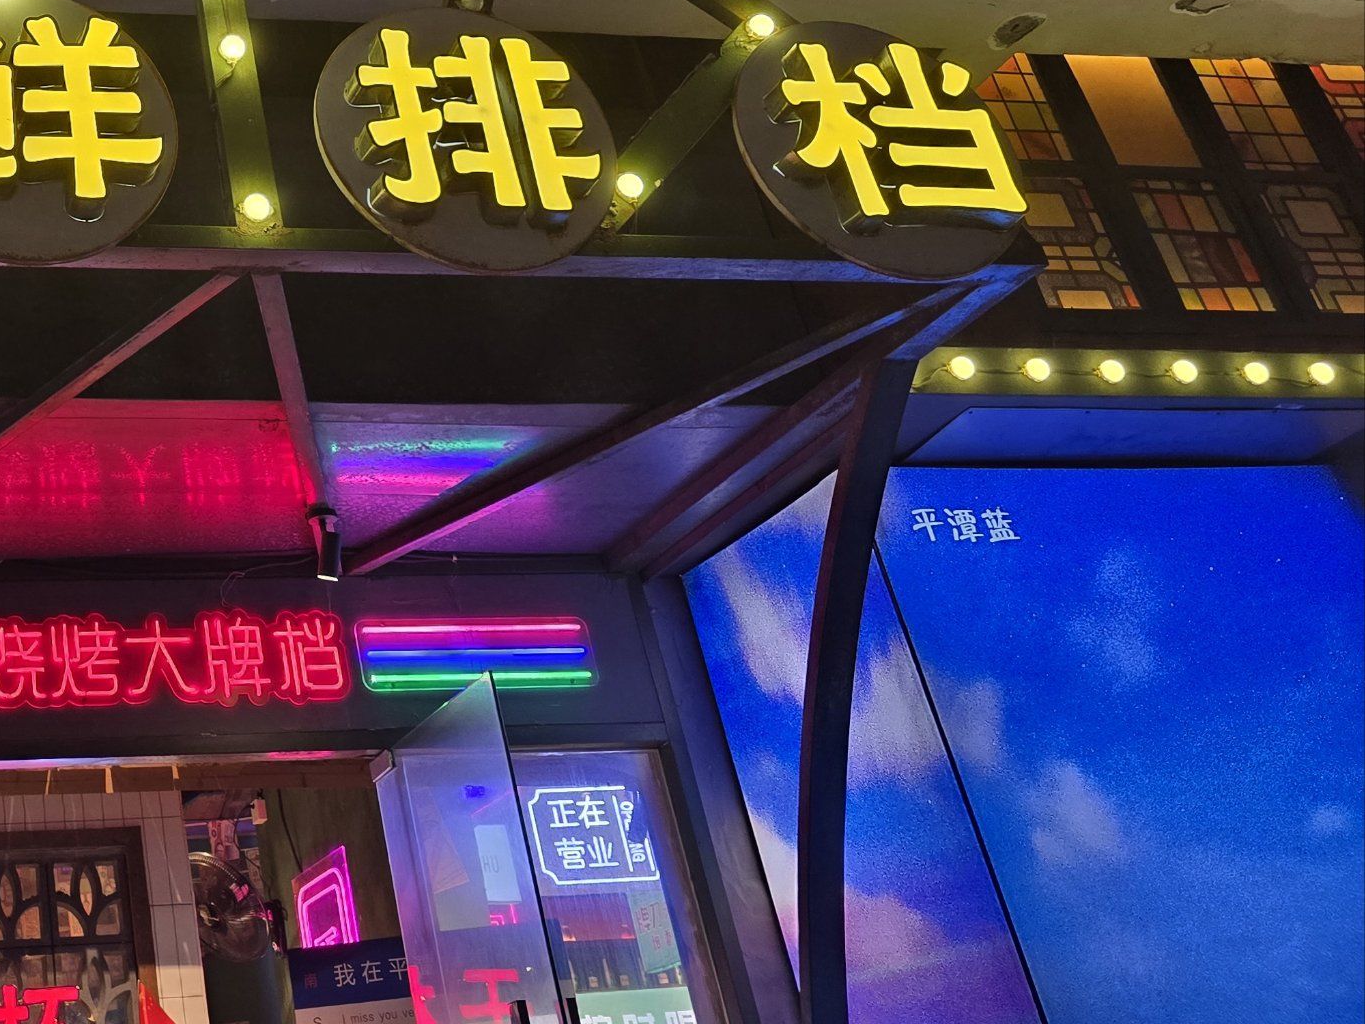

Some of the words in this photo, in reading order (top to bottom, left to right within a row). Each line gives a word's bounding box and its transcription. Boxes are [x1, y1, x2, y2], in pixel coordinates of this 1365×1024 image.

[911, 506, 1021, 543] 平潭蓝
[546, 795, 610, 829] 正在
[553, 836, 620, 870] 营业
[350, 1011, 375, 1022] miss
[378, 1009, 397, 1023] you
